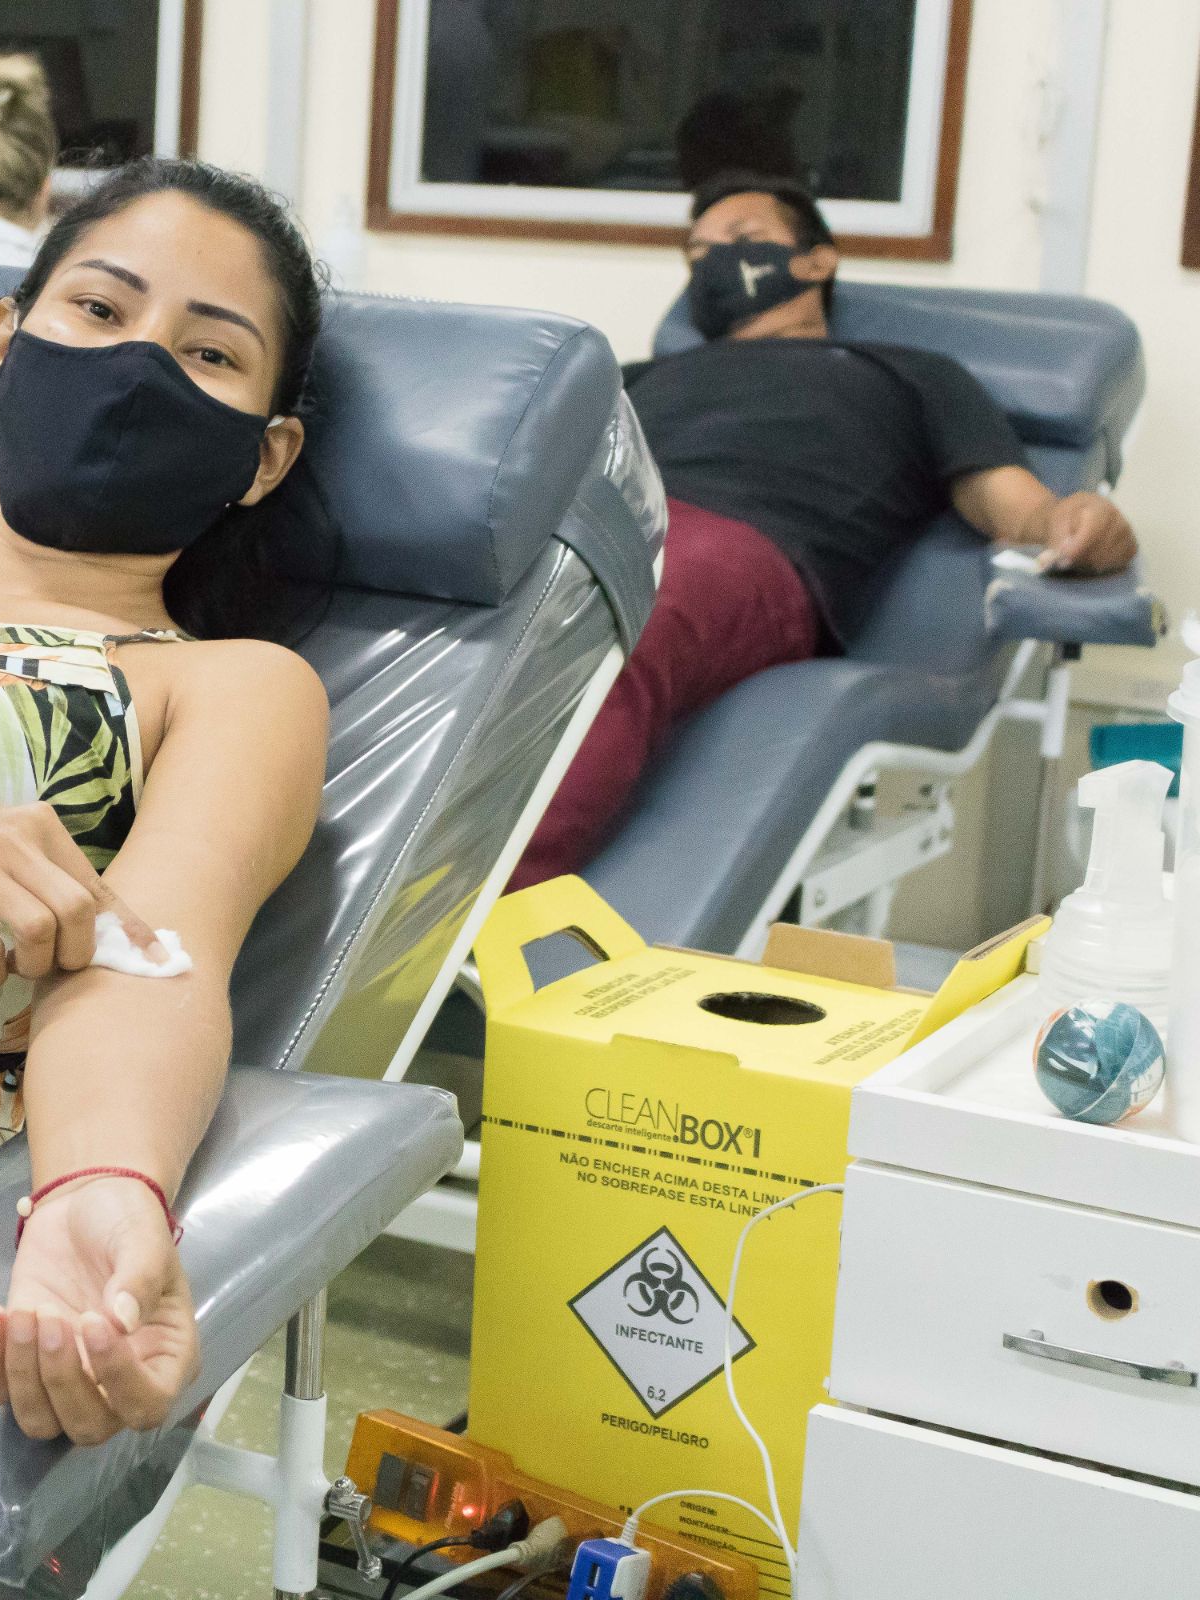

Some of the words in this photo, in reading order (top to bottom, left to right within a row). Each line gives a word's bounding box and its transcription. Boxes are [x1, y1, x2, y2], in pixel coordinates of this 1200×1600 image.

[586, 1119, 623, 1133] descarte
[625, 1126, 672, 1142] inteligente
[559, 1151, 590, 1168] NÃO
[593, 1159, 650, 1180] ENCHER
[653, 1172, 699, 1190] ACIMA
[703, 1181, 749, 1200] DESTA
[577, 1170, 598, 1184] NO
[601, 1175, 686, 1202] SOBREPASE
[689, 1194, 726, 1210] ESTA
[729, 1202, 771, 1220] LINE
[615, 1323, 704, 1354] INFECTANTE
[646, 1386, 667, 1402] 6.2
[601, 1412, 710, 1449] PERIGO/PELIGRO
